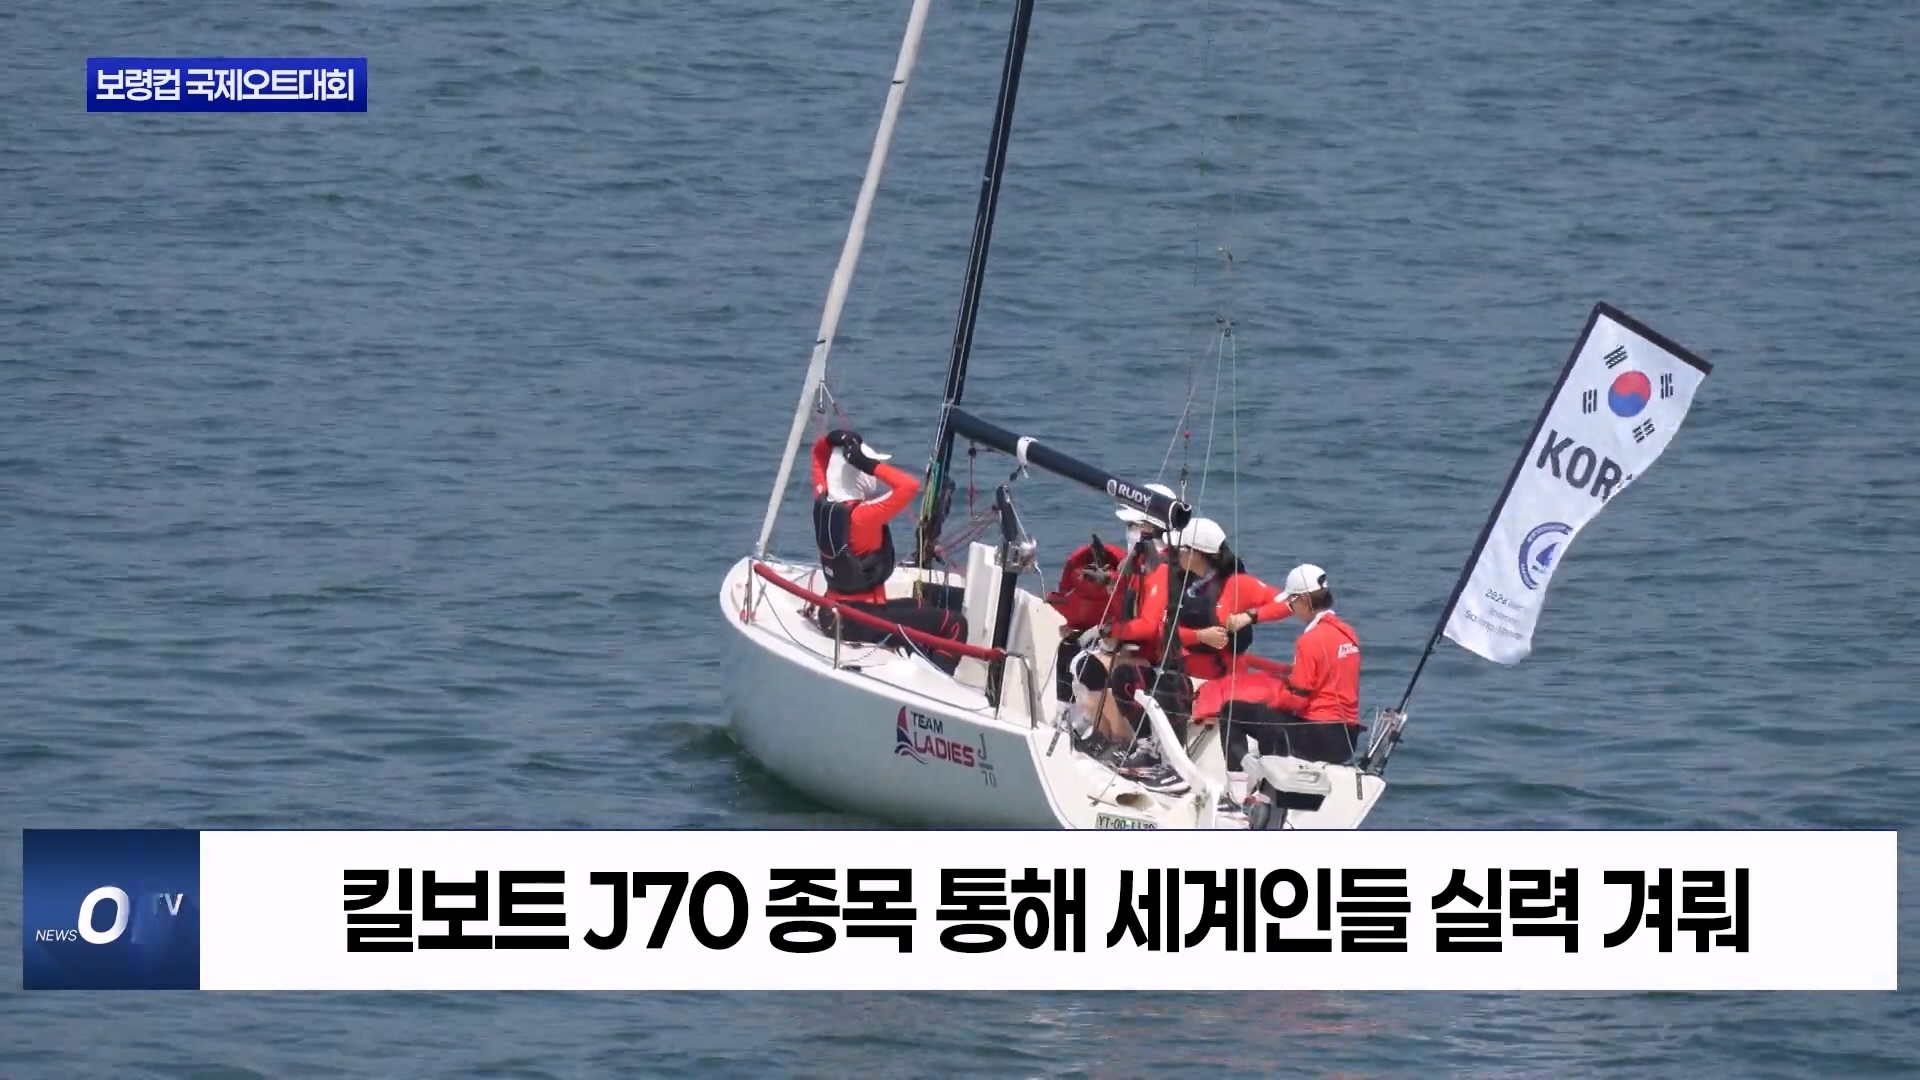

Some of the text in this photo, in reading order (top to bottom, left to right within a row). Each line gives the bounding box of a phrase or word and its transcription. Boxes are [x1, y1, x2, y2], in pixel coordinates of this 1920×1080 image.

[911, 711, 943, 734] TEAM
[914, 732, 974, 768] LADIES
[978, 733, 987, 760] J
[981, 770, 997, 788] 70
